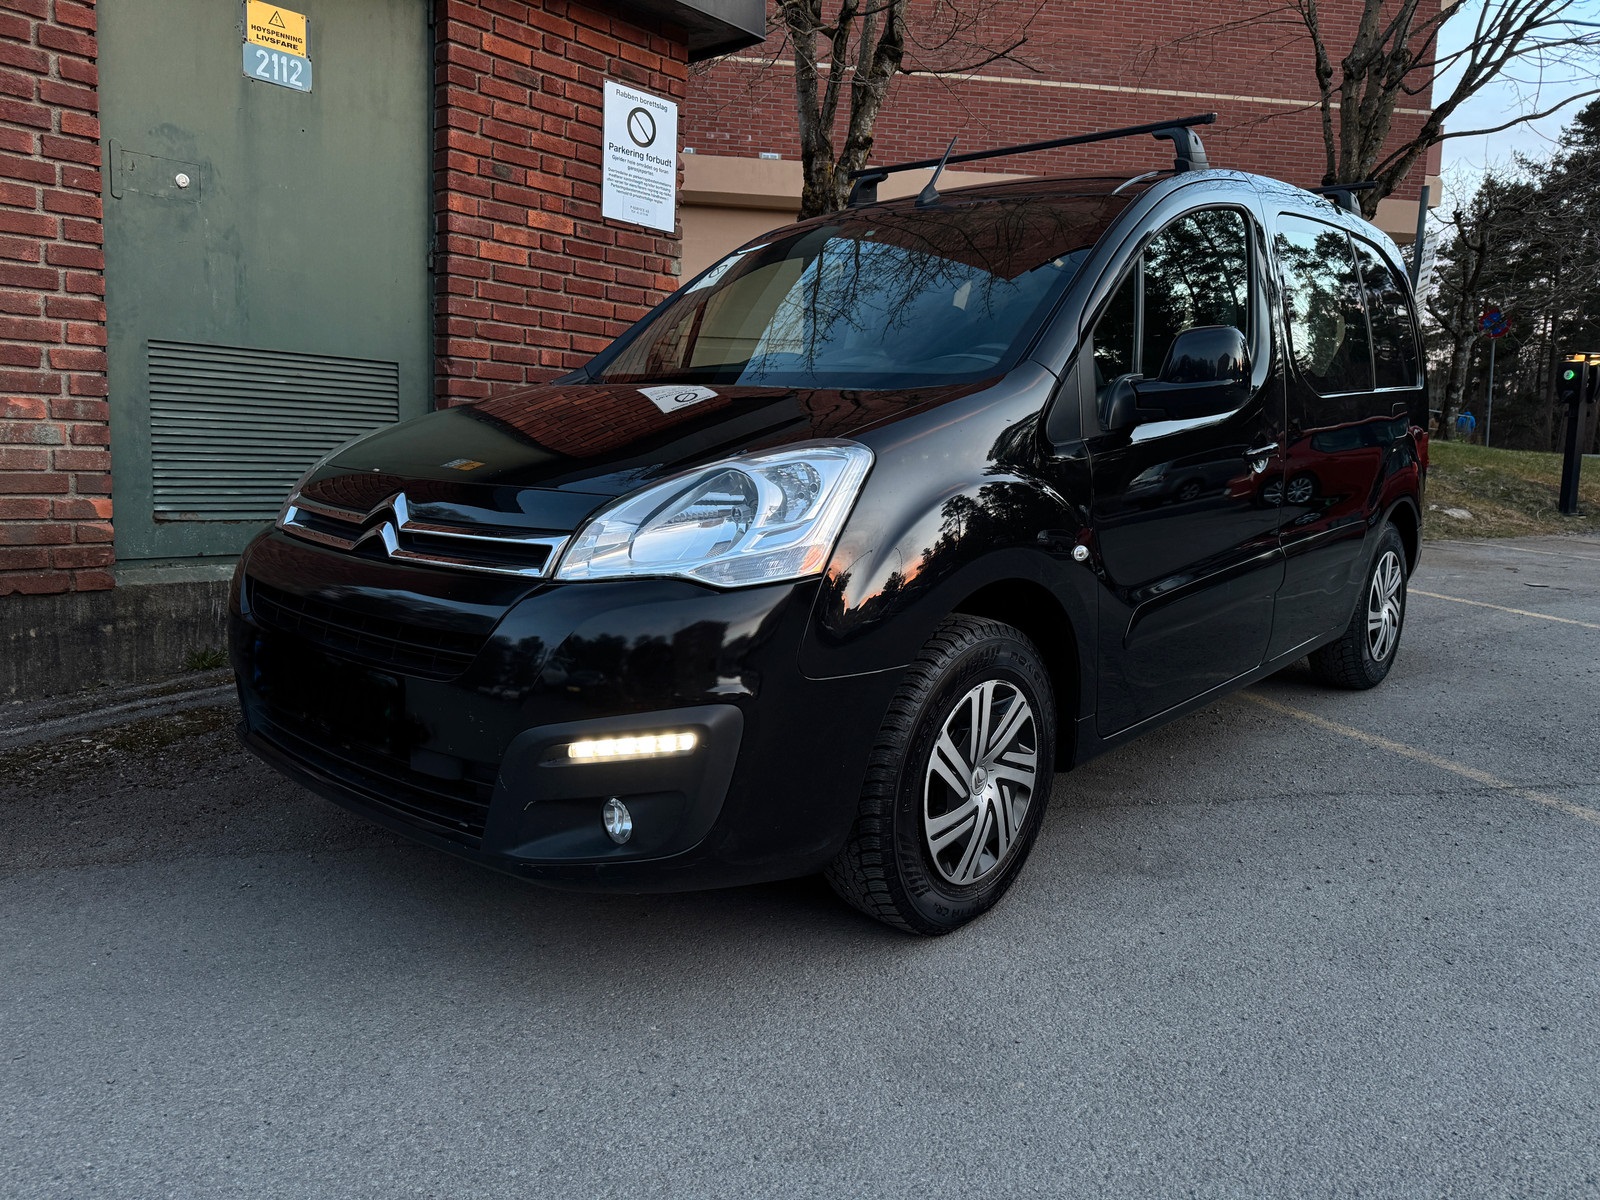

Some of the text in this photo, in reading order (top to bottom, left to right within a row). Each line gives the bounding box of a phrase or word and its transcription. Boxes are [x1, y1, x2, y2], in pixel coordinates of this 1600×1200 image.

[251, 24, 303, 44] HØYSPENNING
[256, 33, 299, 51] LIVSFARE
[256, 49, 303, 87] 2112
[615, 88, 668, 112] Rabben borettslag
[608, 142, 672, 168] Parkering forbudt
